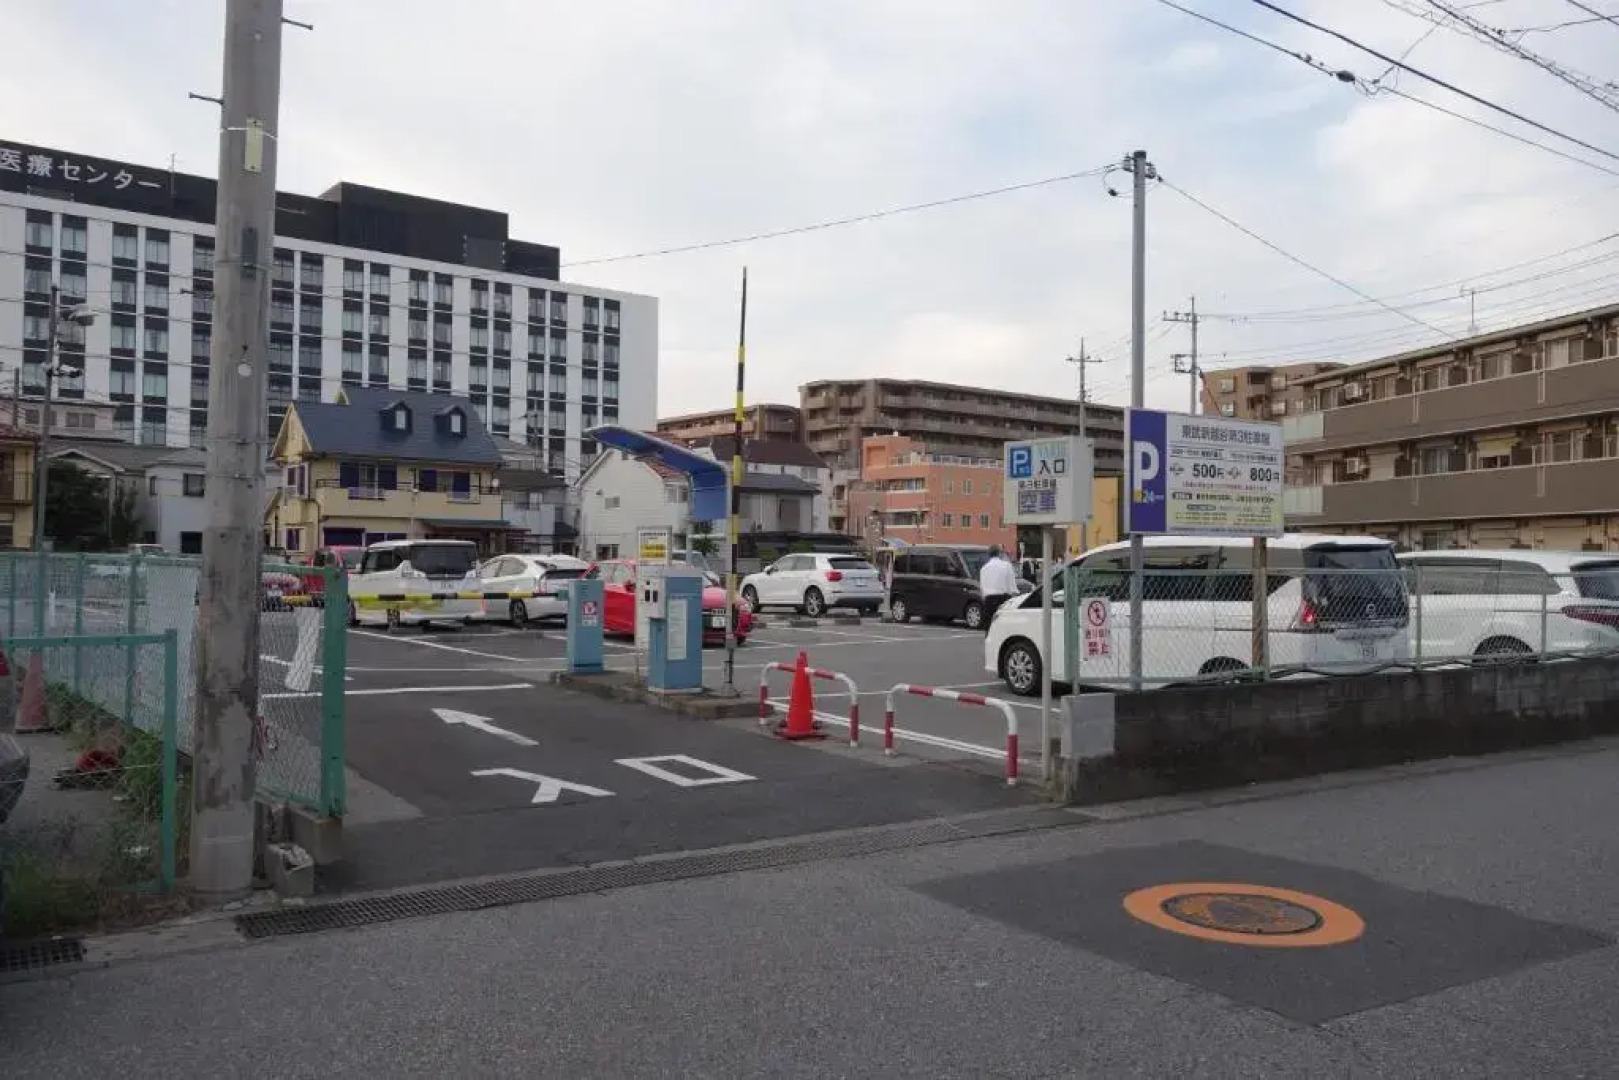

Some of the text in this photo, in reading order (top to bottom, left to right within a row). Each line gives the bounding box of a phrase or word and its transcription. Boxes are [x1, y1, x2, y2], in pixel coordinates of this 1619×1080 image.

[0, 149, 161, 189] 医療センター
[1012, 450, 1029, 475] P
[1039, 458, 1065, 475] 入口
[1133, 441, 1160, 490] P
